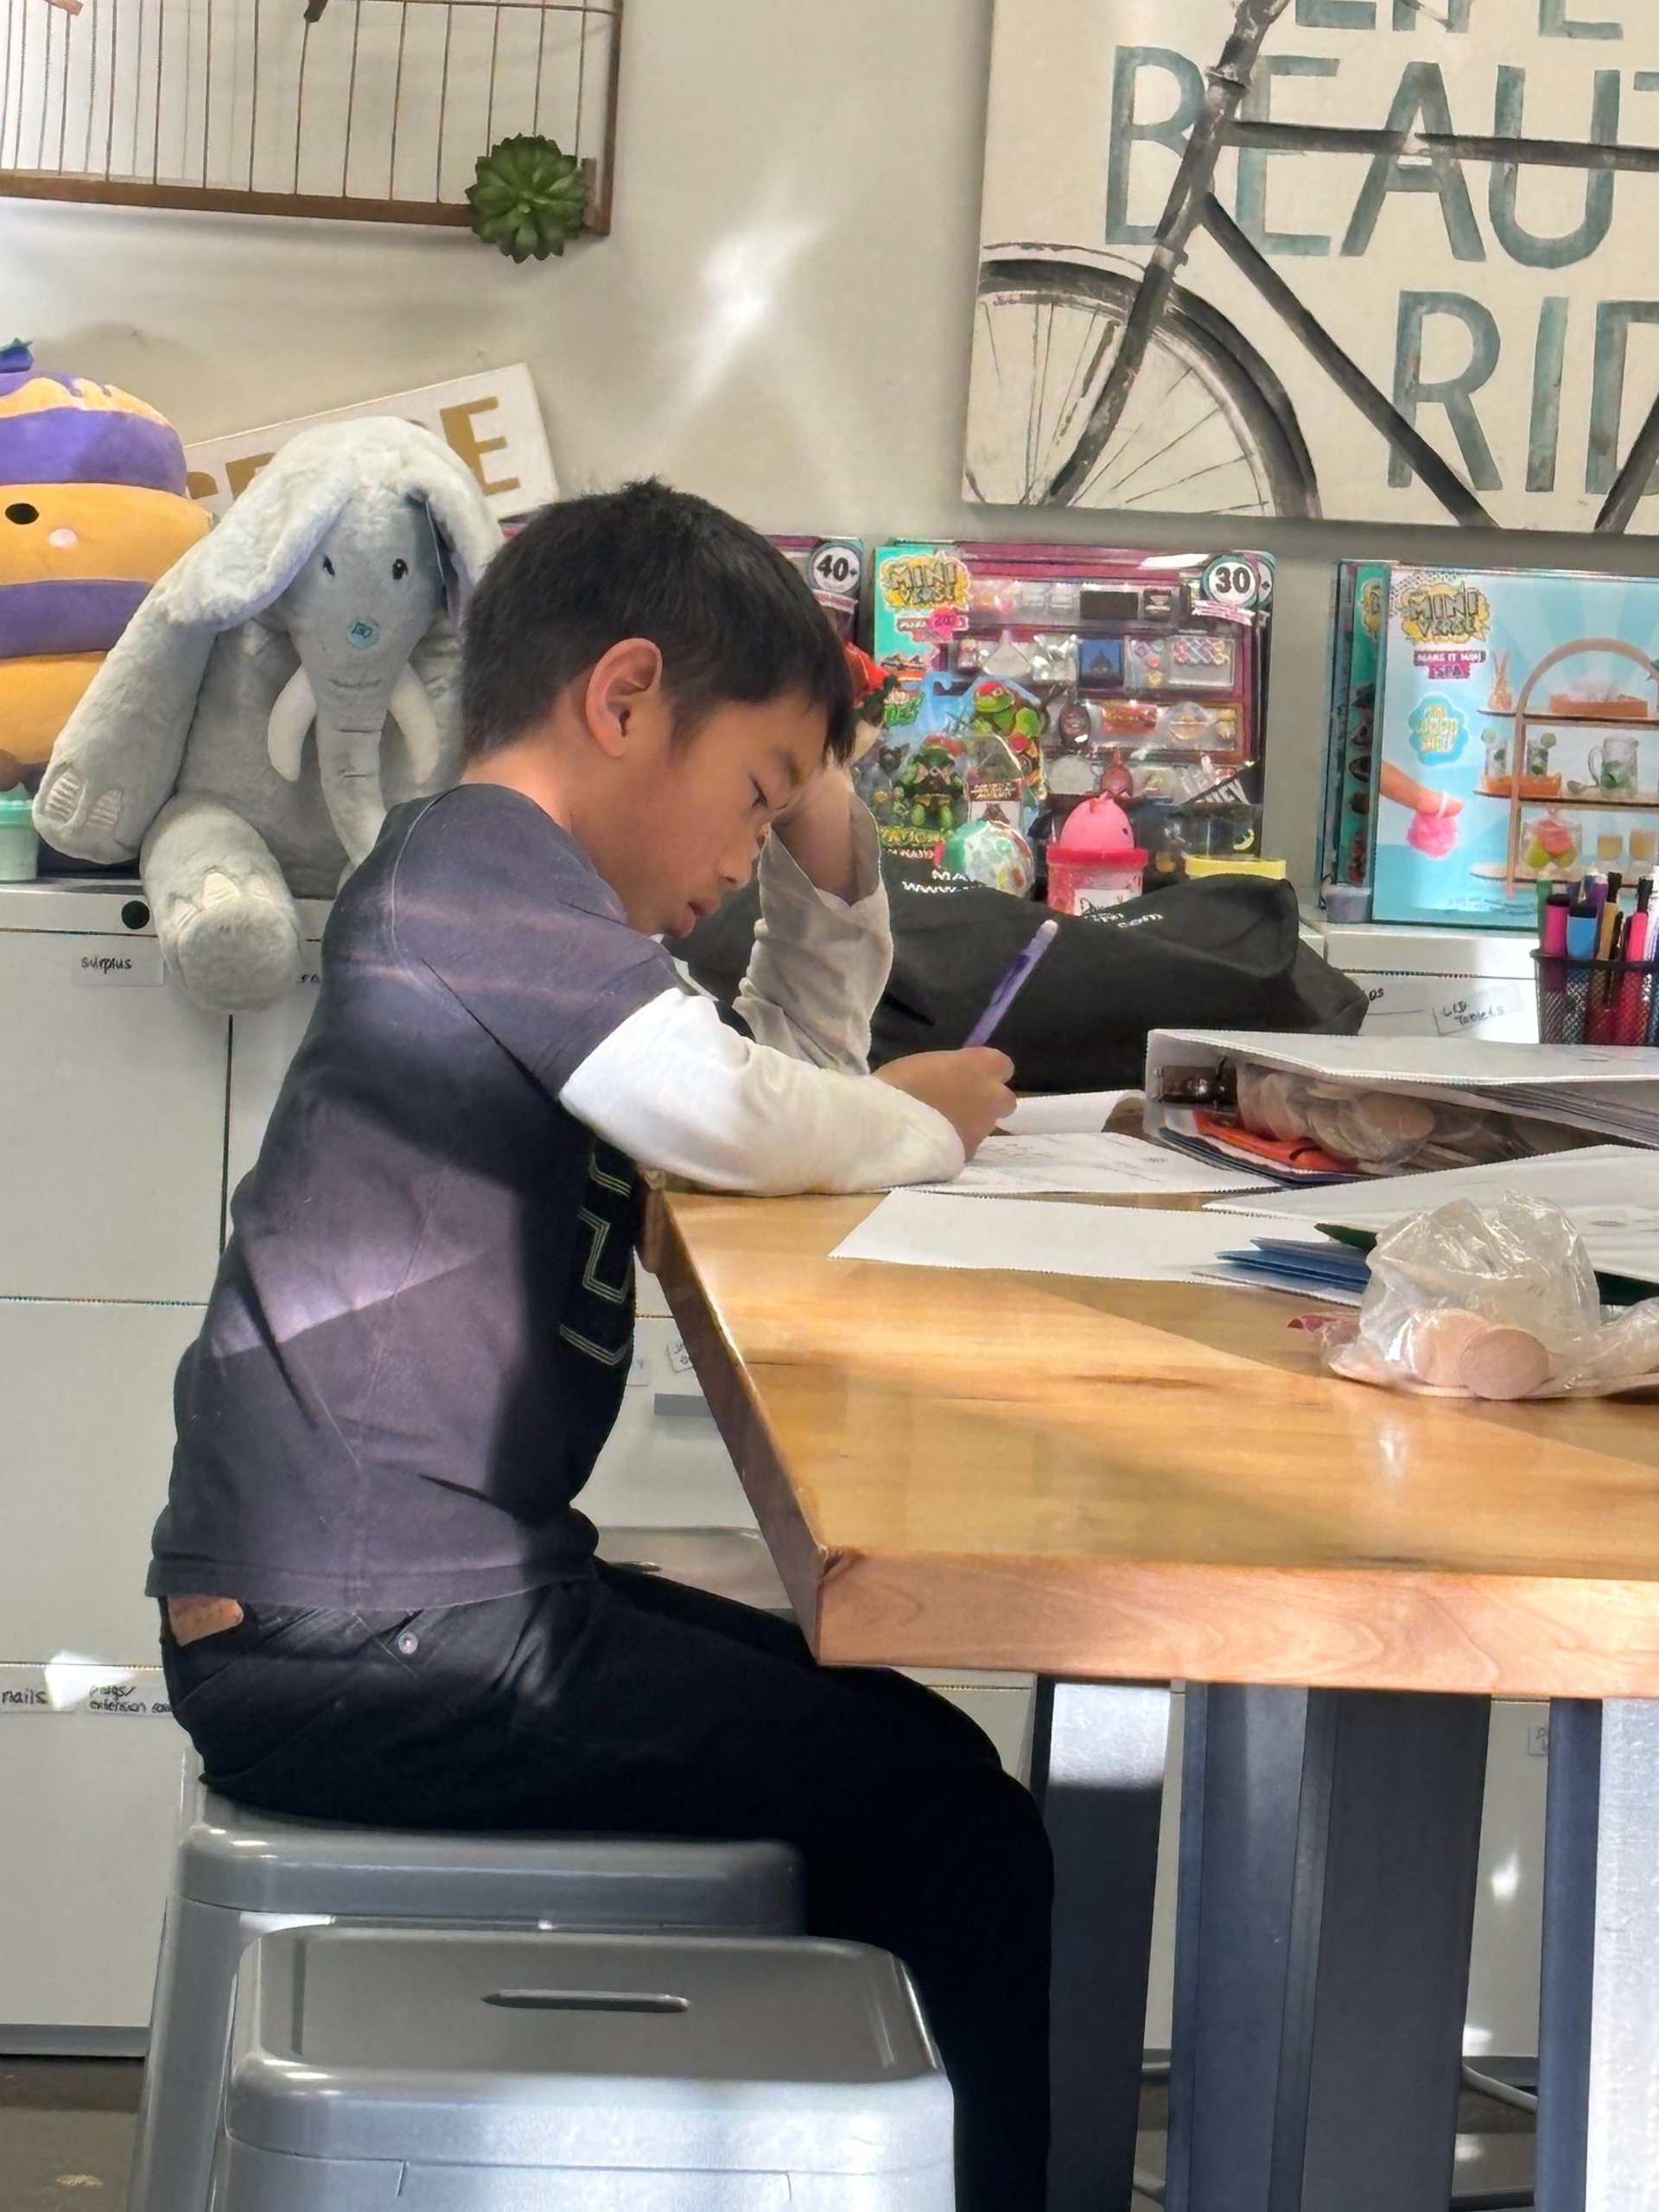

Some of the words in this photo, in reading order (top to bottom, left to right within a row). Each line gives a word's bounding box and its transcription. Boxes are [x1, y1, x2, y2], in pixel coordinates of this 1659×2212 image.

[889, 563, 957, 591] MINI
[1215, 567, 1251, 594] 30
[1408, 591, 1478, 620] MINI
[1417, 616, 1476, 638] VERSE
[1447, 652, 1457, 662] IT
[1434, 664, 1463, 679] SPA
[81, 957, 131, 974] surplus
[2, 1688, 48, 1704] nails
